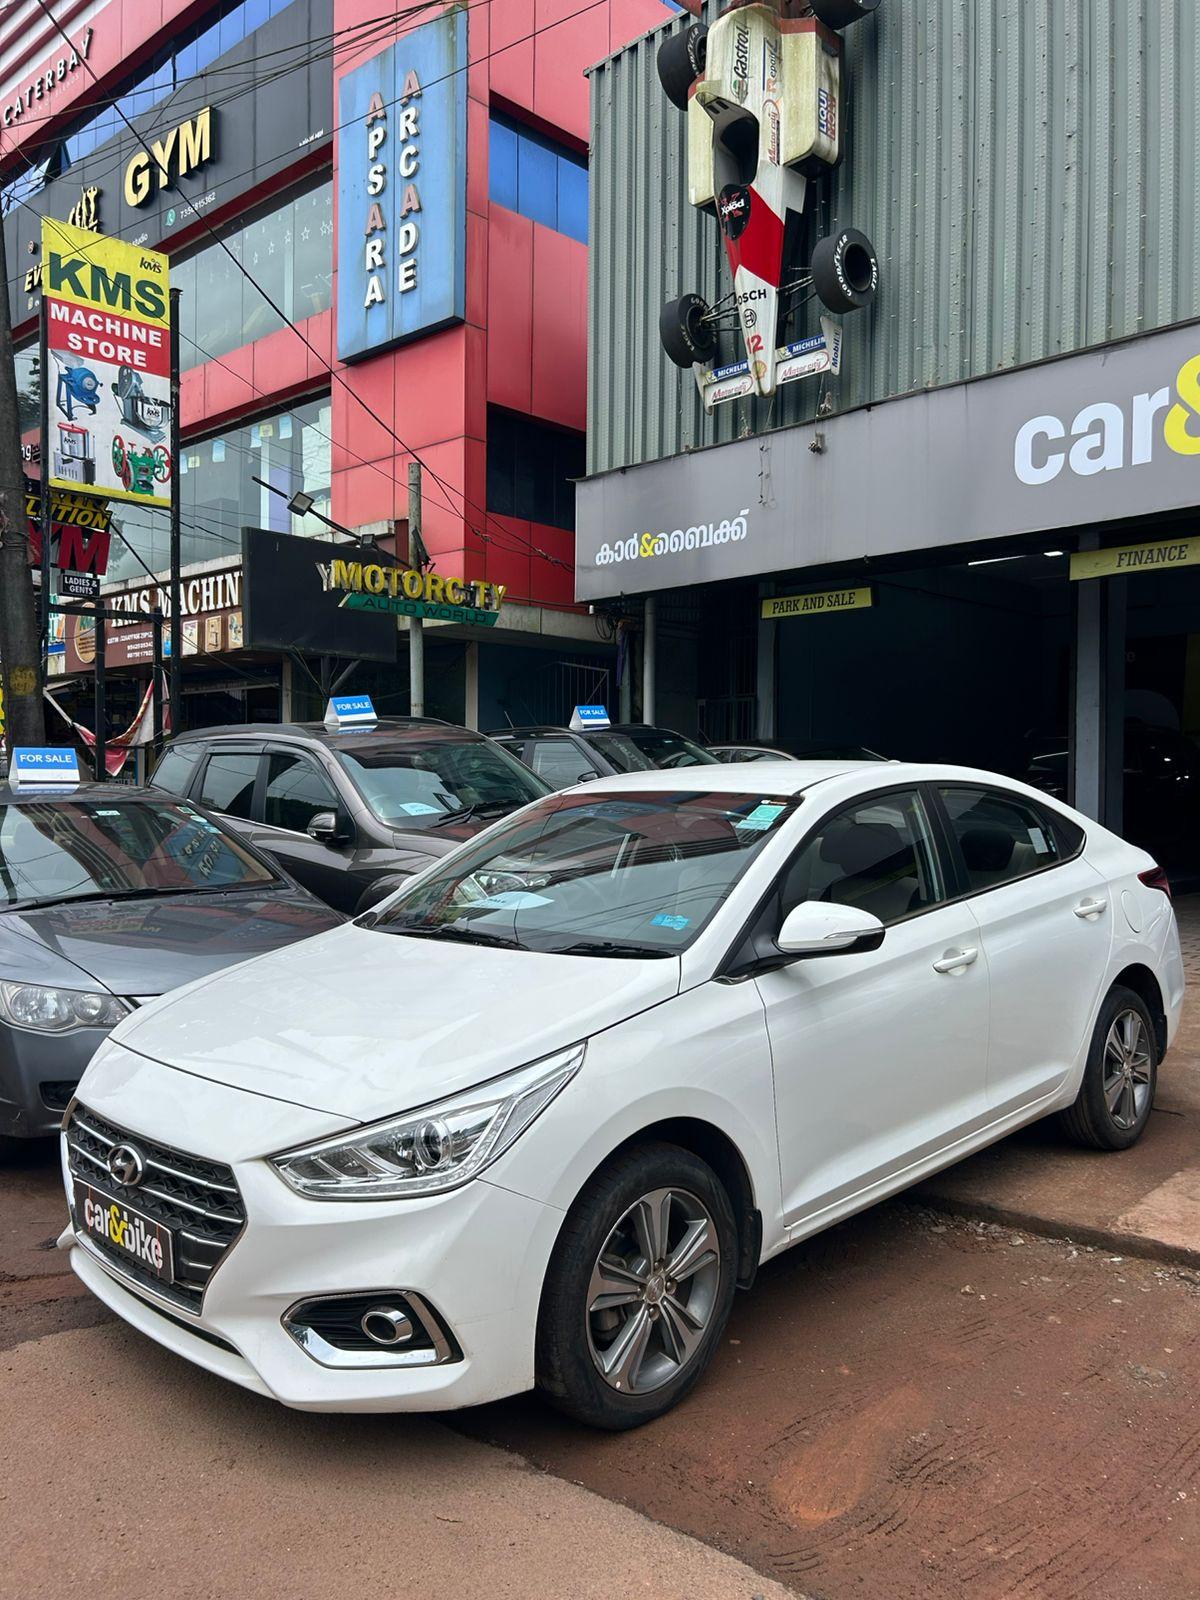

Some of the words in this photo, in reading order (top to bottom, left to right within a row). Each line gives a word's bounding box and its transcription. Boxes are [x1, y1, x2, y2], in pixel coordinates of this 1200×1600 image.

[734, 26, 749, 79] Castrol
[3, 28, 94, 126] CATERBAY
[819, 90, 828, 133] LIQUI
[124, 105, 213, 206] GYM
[365, 91, 386, 309] APSARA
[398, 70, 422, 294] ARCADE
[49, 252, 166, 318] KMS
[51, 302, 162, 347] MACHINE
[67, 333, 147, 367] STORE
[746, 334, 764, 354] 12
[832, 339, 840, 368] Mobil
[1116, 544, 1189, 567] FINANCE
[65, 577, 90, 586] LADIES
[69, 585, 93, 595] GENTS
[157, 572, 243, 618] MACHIN
[363, 599, 417, 614] AUTO
[423, 604, 487, 622] WORLD
[772, 598, 801, 614] PARK
[802, 596, 825, 611] AND
[826, 592, 856, 608] SALE
[336, 702, 351, 710] FOR
[352, 701, 371, 709] SALE
[20, 754, 43, 763] FOR
[45, 753, 72, 763] SALE
[84, 1198, 163, 1269] car&bike
